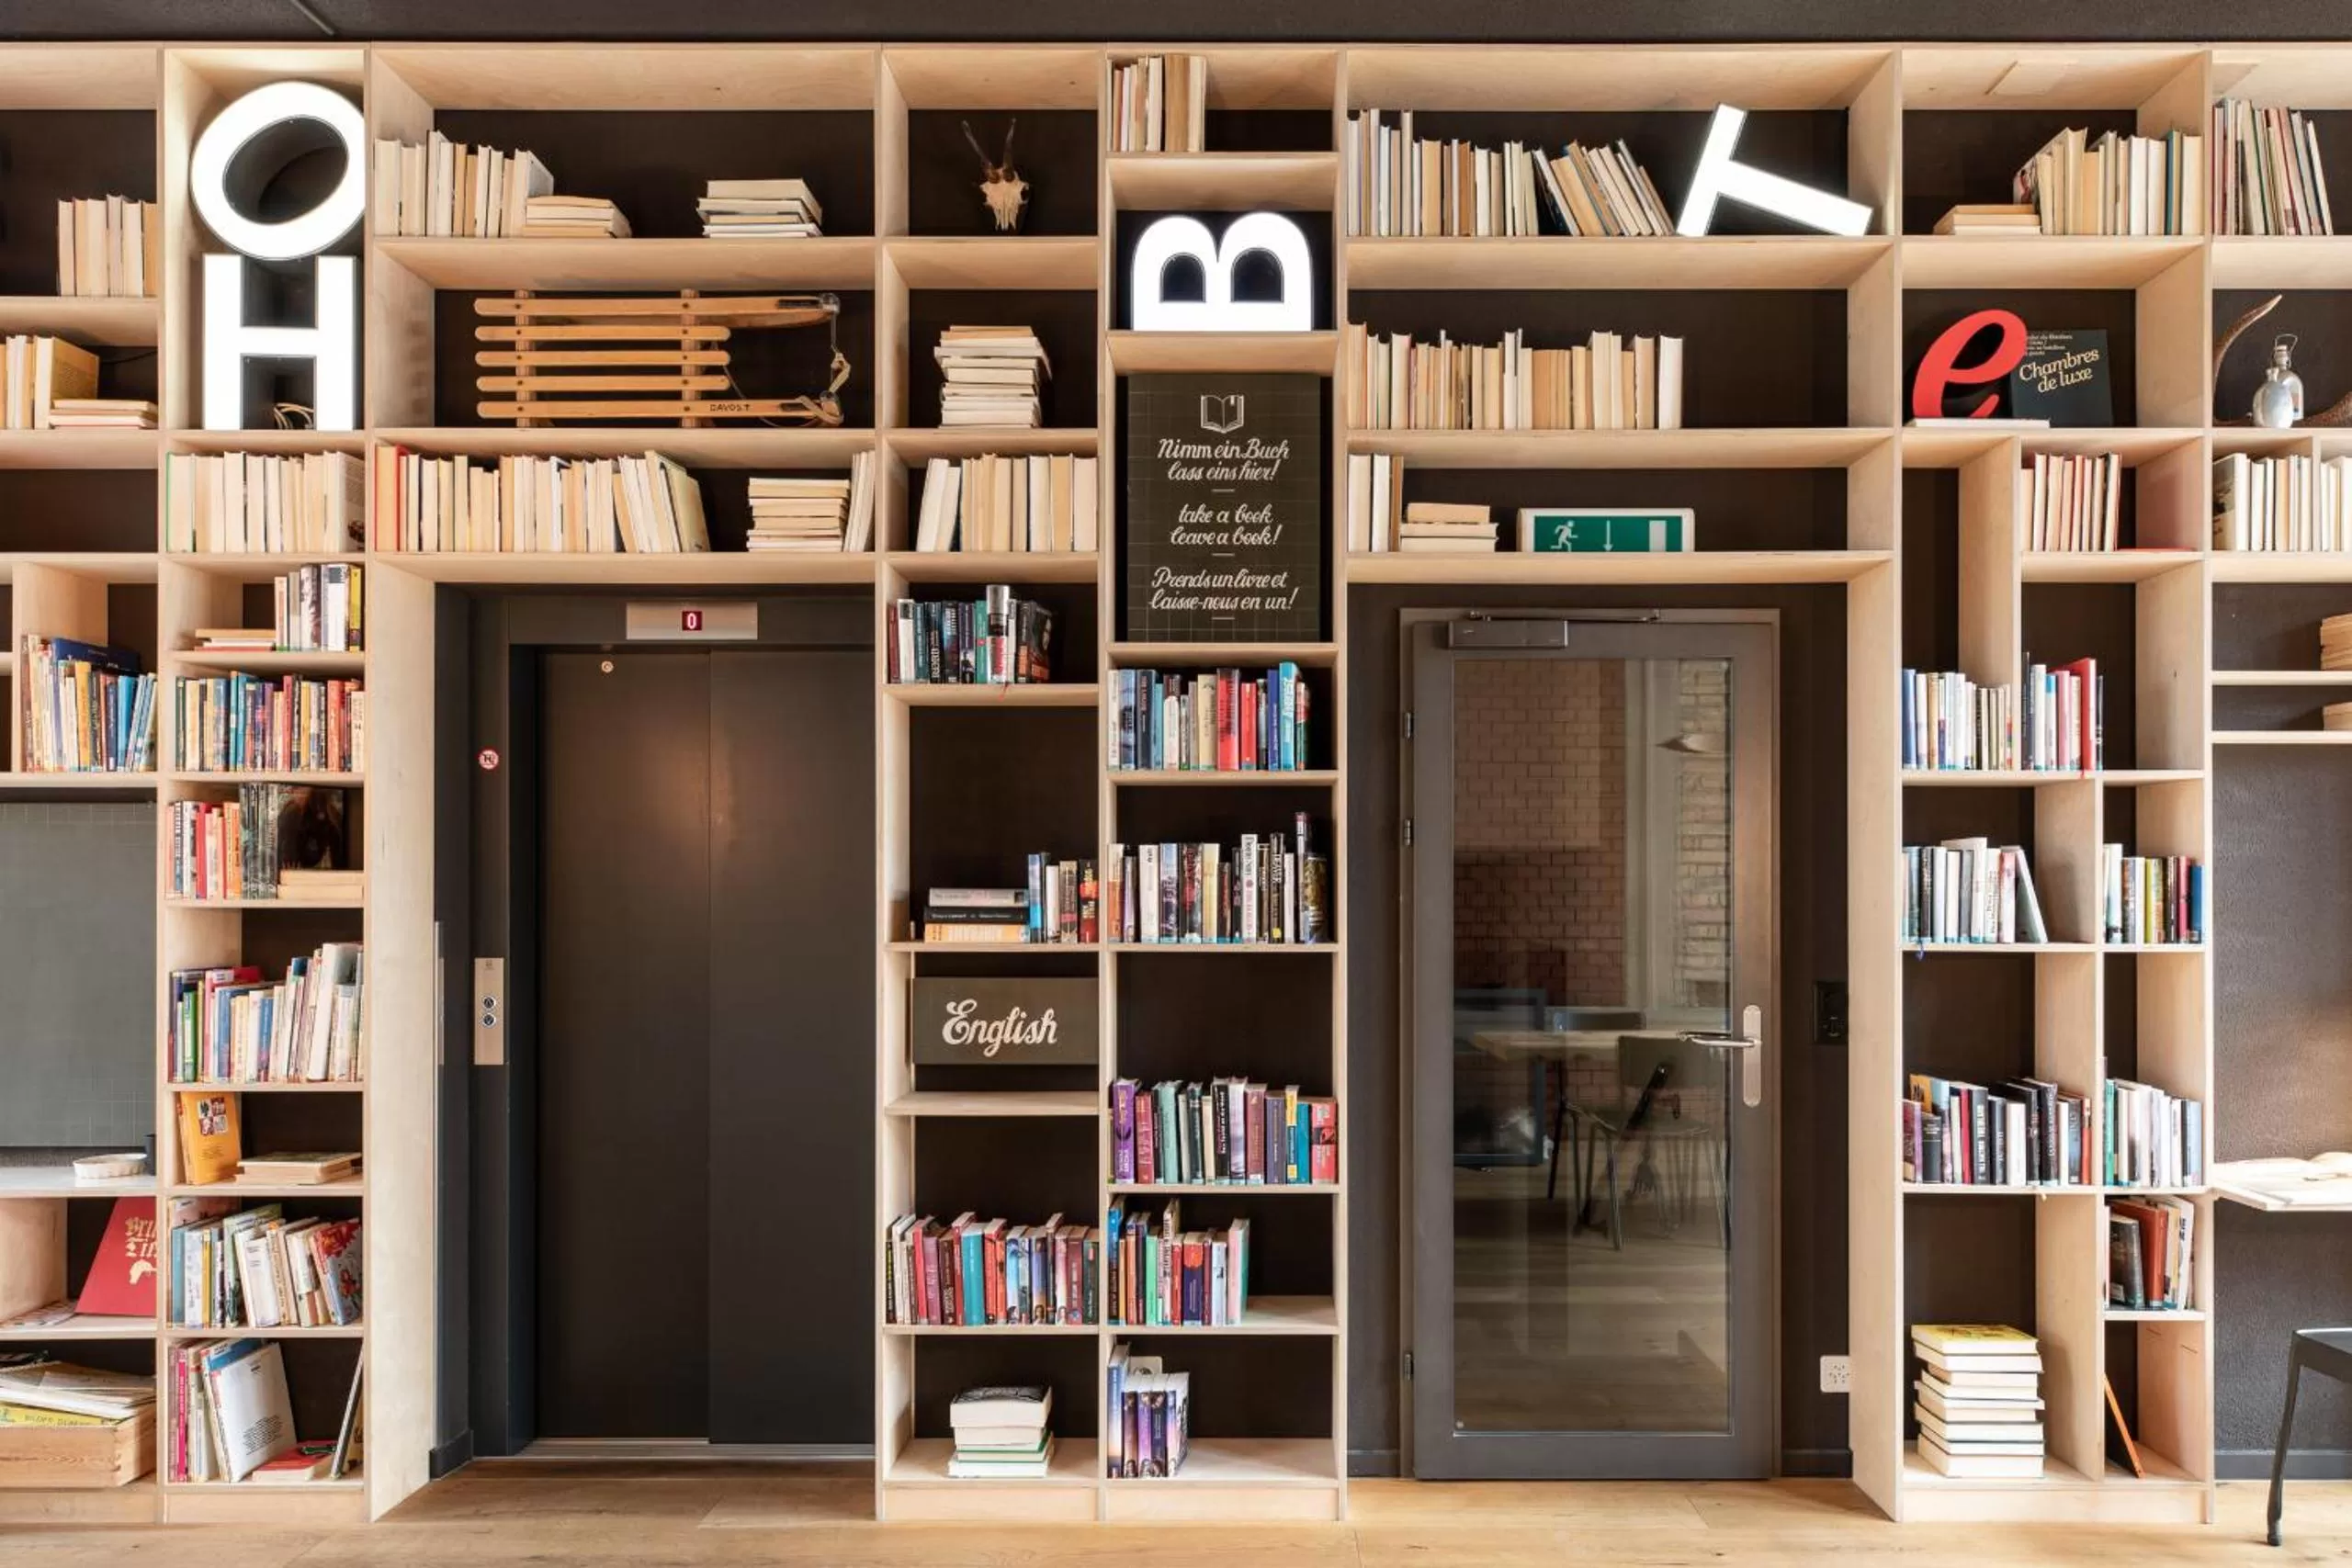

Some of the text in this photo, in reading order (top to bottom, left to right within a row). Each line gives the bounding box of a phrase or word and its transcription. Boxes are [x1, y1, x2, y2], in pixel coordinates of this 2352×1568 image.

[191, 81, 365, 260] O
[1677, 103, 1872, 236] T
[1131, 211, 1312, 331] B
[203, 254, 356, 430] H
[1913, 309, 2027, 418] e
[2019, 349, 2099, 380] Chambres
[2038, 368, 2093, 392] de luxe
[1157, 437, 1290, 459] Nimm ein Buch
[1167, 458, 1282, 481] lass eins hier!
[1178, 502, 1273, 524] take a book
[1170, 525, 1283, 546] leave a book!
[1151, 566, 1288, 589] Prends un livre et
[1239, 595, 1261, 611] en
[1264, 587, 1299, 611] un!
[687, 613, 696, 630] 0
[942, 998, 1057, 1057] English
